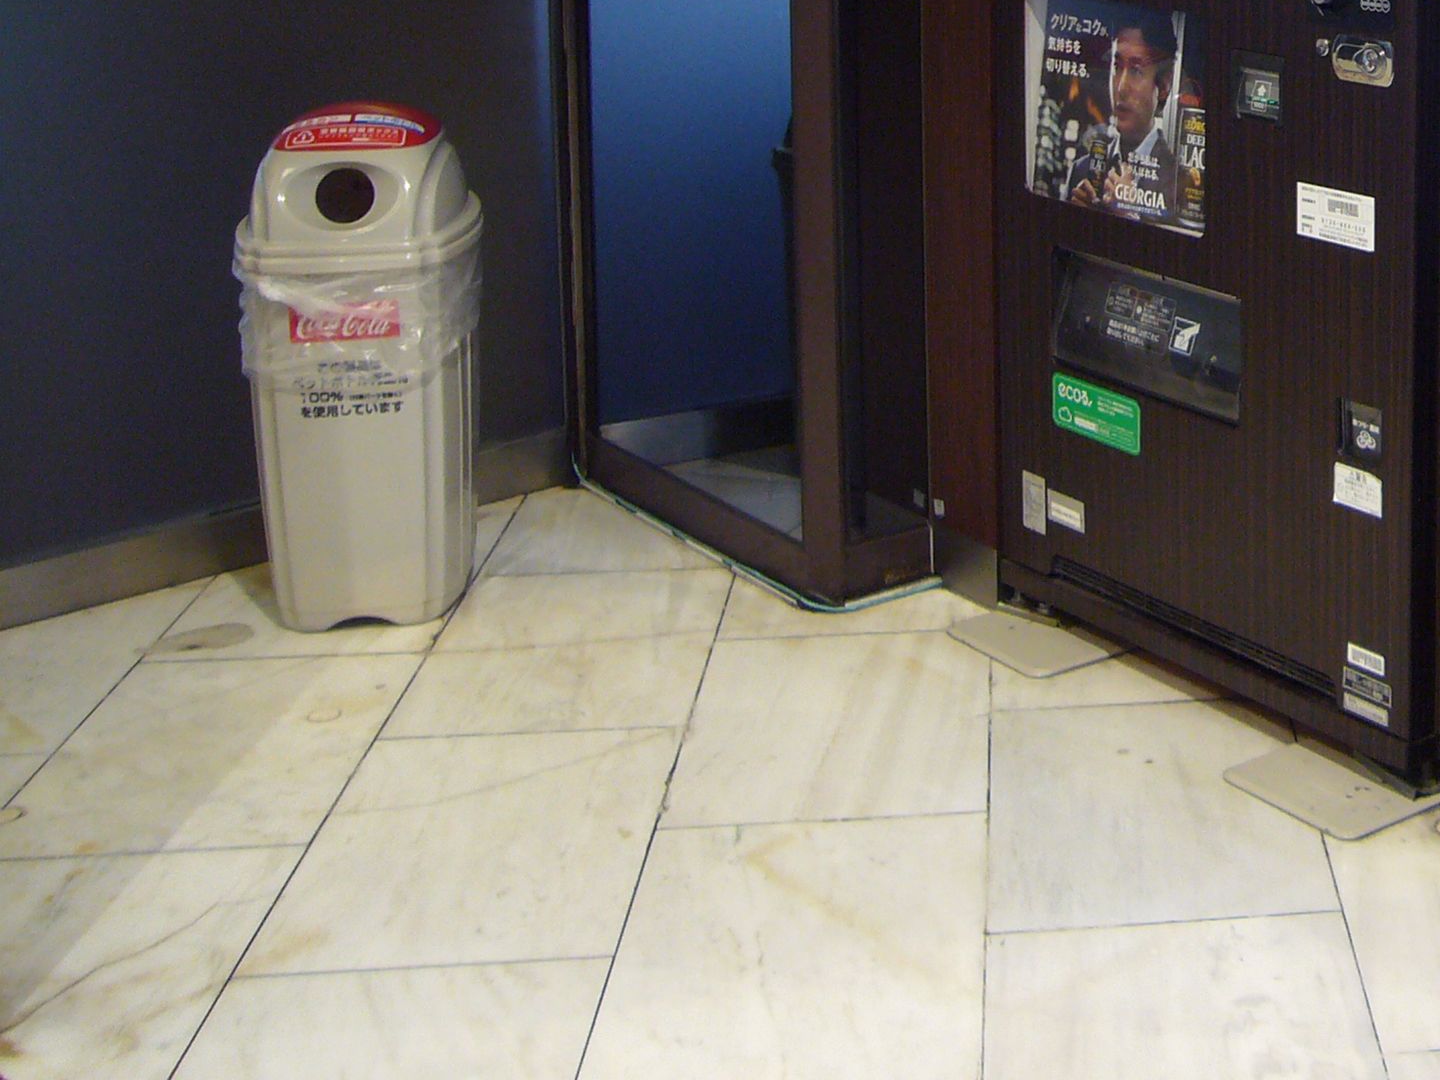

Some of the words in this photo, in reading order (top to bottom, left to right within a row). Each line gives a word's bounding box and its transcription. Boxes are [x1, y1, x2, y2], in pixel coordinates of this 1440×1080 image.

[1047, 35, 1082, 55] 気持ちを
[1114, 182, 1168, 210] GEORGIA
[301, 400, 404, 419] を使用しています
